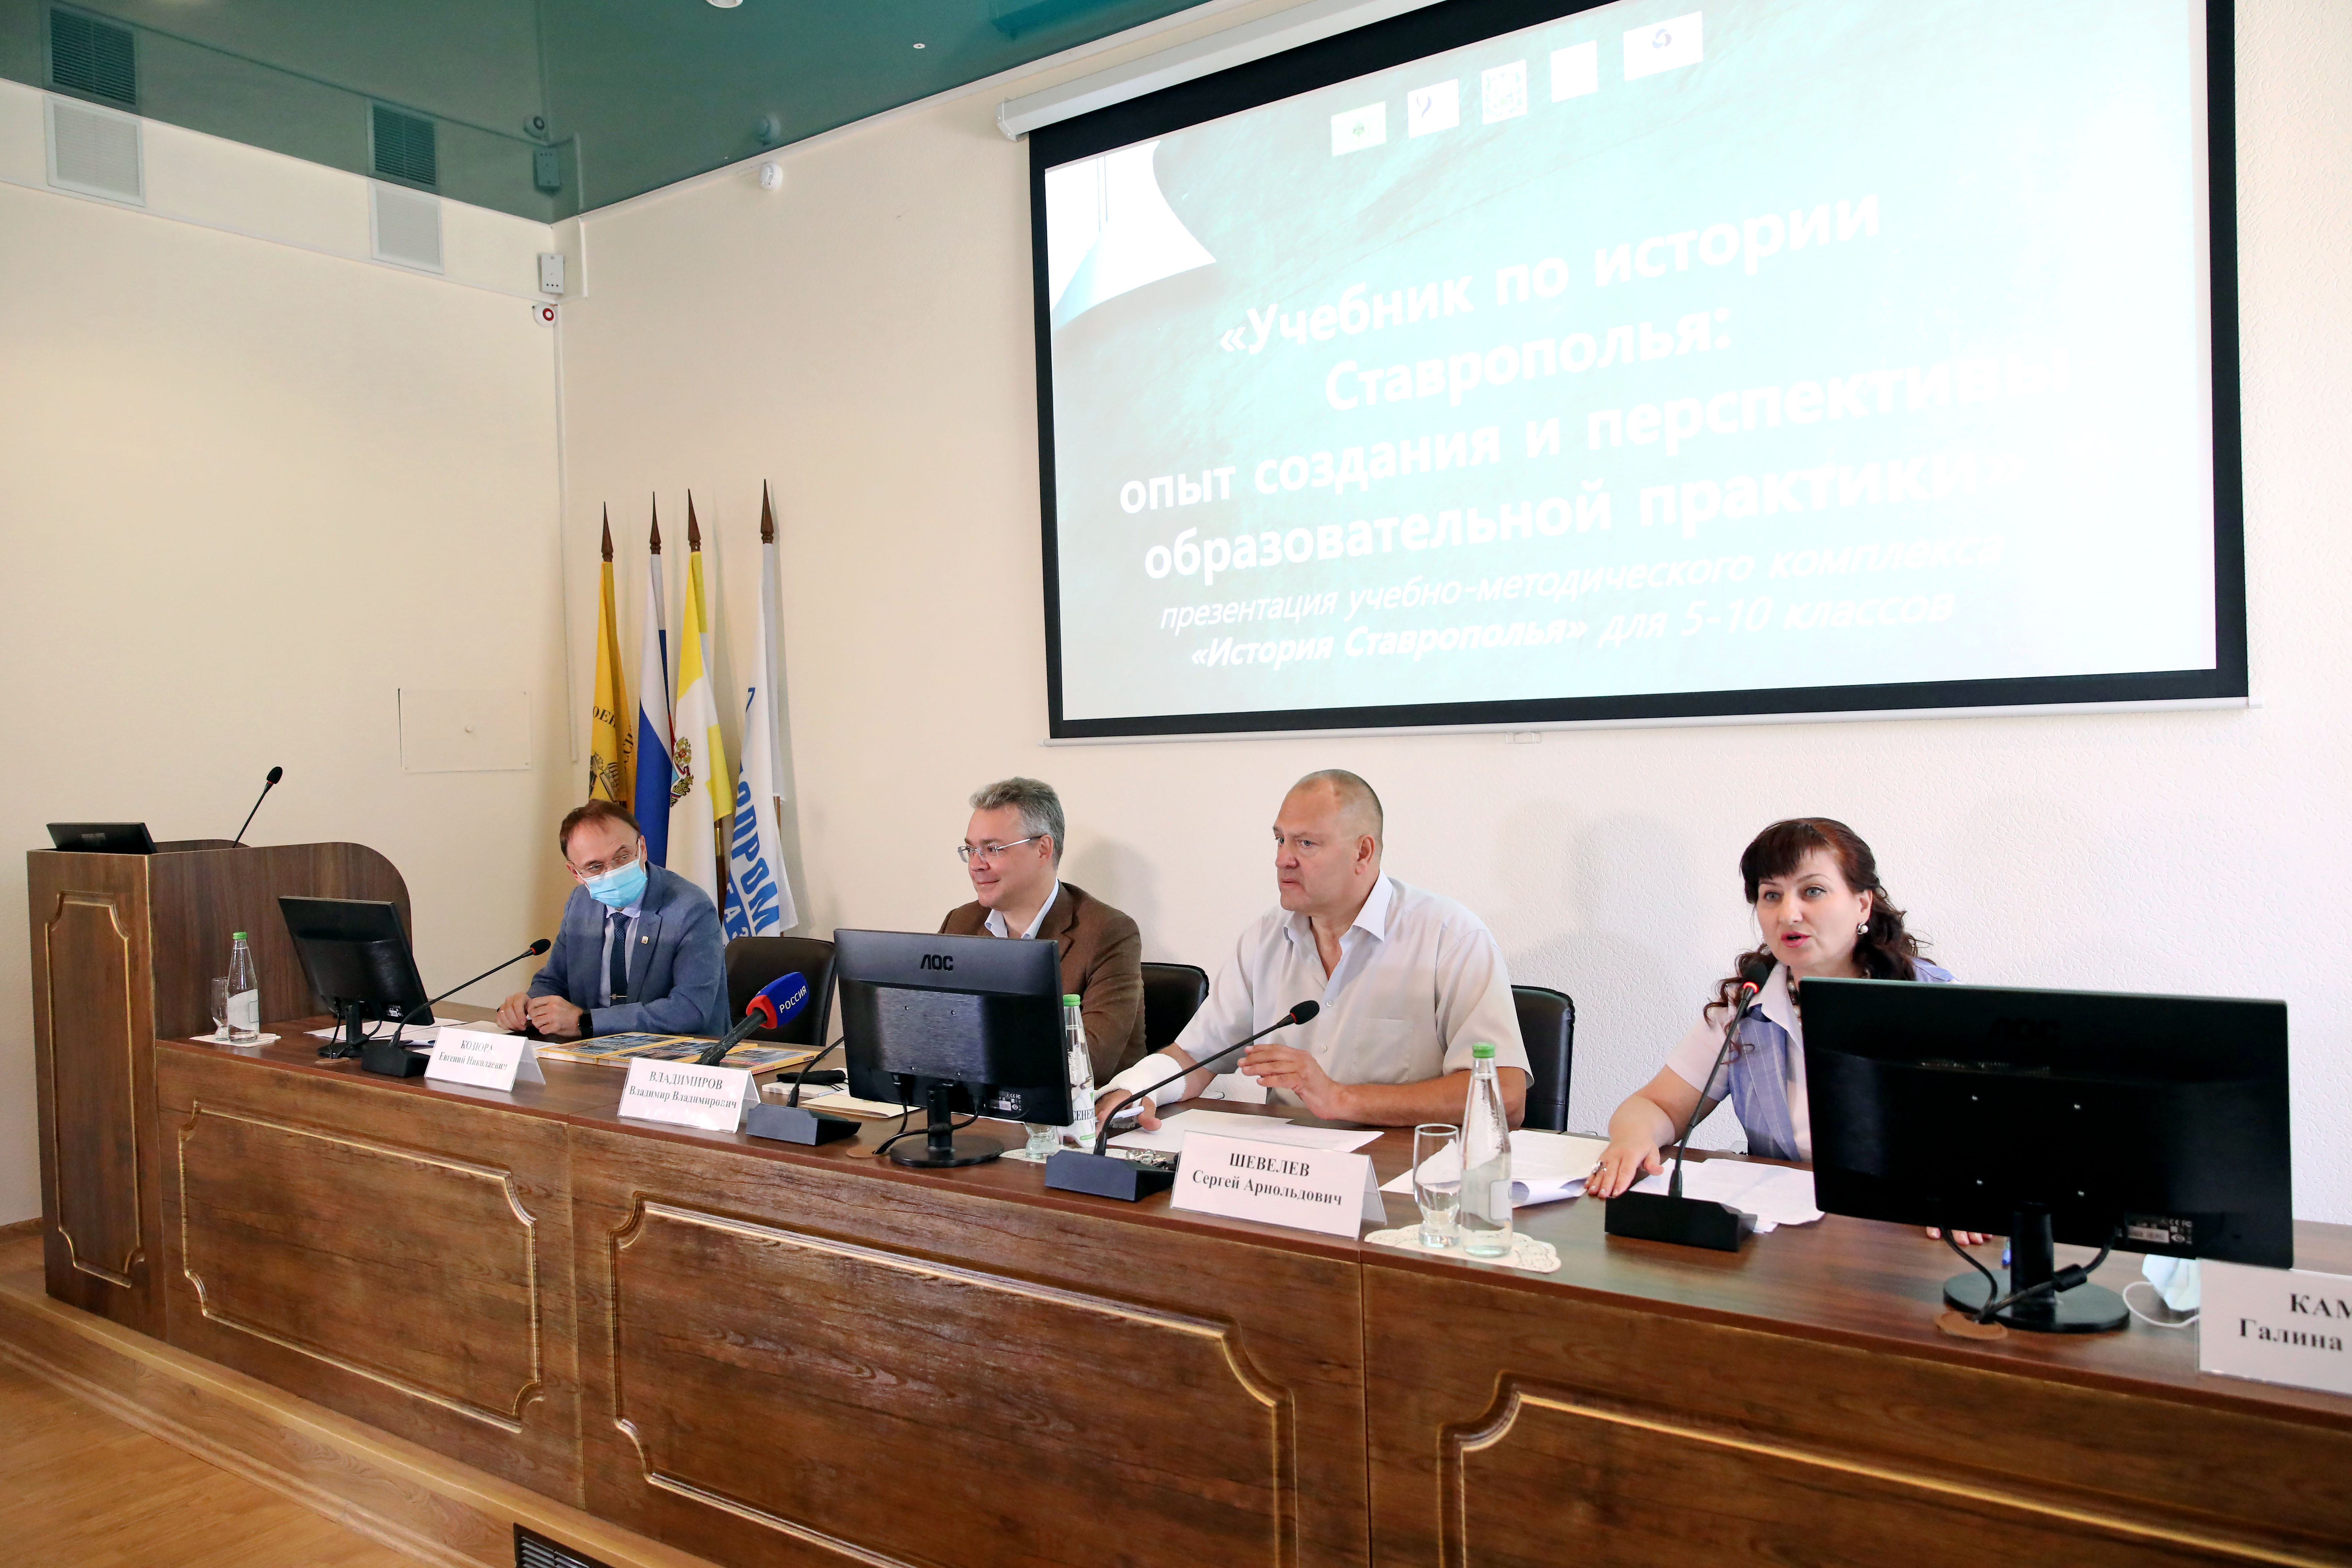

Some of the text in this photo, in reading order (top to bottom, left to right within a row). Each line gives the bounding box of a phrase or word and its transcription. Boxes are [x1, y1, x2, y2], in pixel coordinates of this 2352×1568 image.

[1220, 194, 1879, 354] «Учебник по истории
[1326, 306, 1731, 410] Ставрополья:
[1120, 346, 2070, 513] опыт создания и перспективы
[1145, 478, 1611, 586] образовательной
[1160, 535, 2004, 636] презентация учебно-методического комплекса
[1191, 592, 1956, 671] «История Ставрополья» для 5-10 классов
[920, 954, 953, 971] AOC
[779, 985, 807, 1013] РОССИЯ
[439, 1052, 508, 1070] Евгений Николаевич
[460, 1040, 493, 1053] КОЗЮРА
[629, 1085, 737, 1108] Владимир Владимирович
[649, 1071, 723, 1090] ВЛАДИМИРОВ
[1229, 1153, 1310, 1177] ШЕВЕЛЕВ
[1192, 1169, 1342, 1205] Сергей Арнольдович
[2240, 1318, 2343, 1351] Галина
